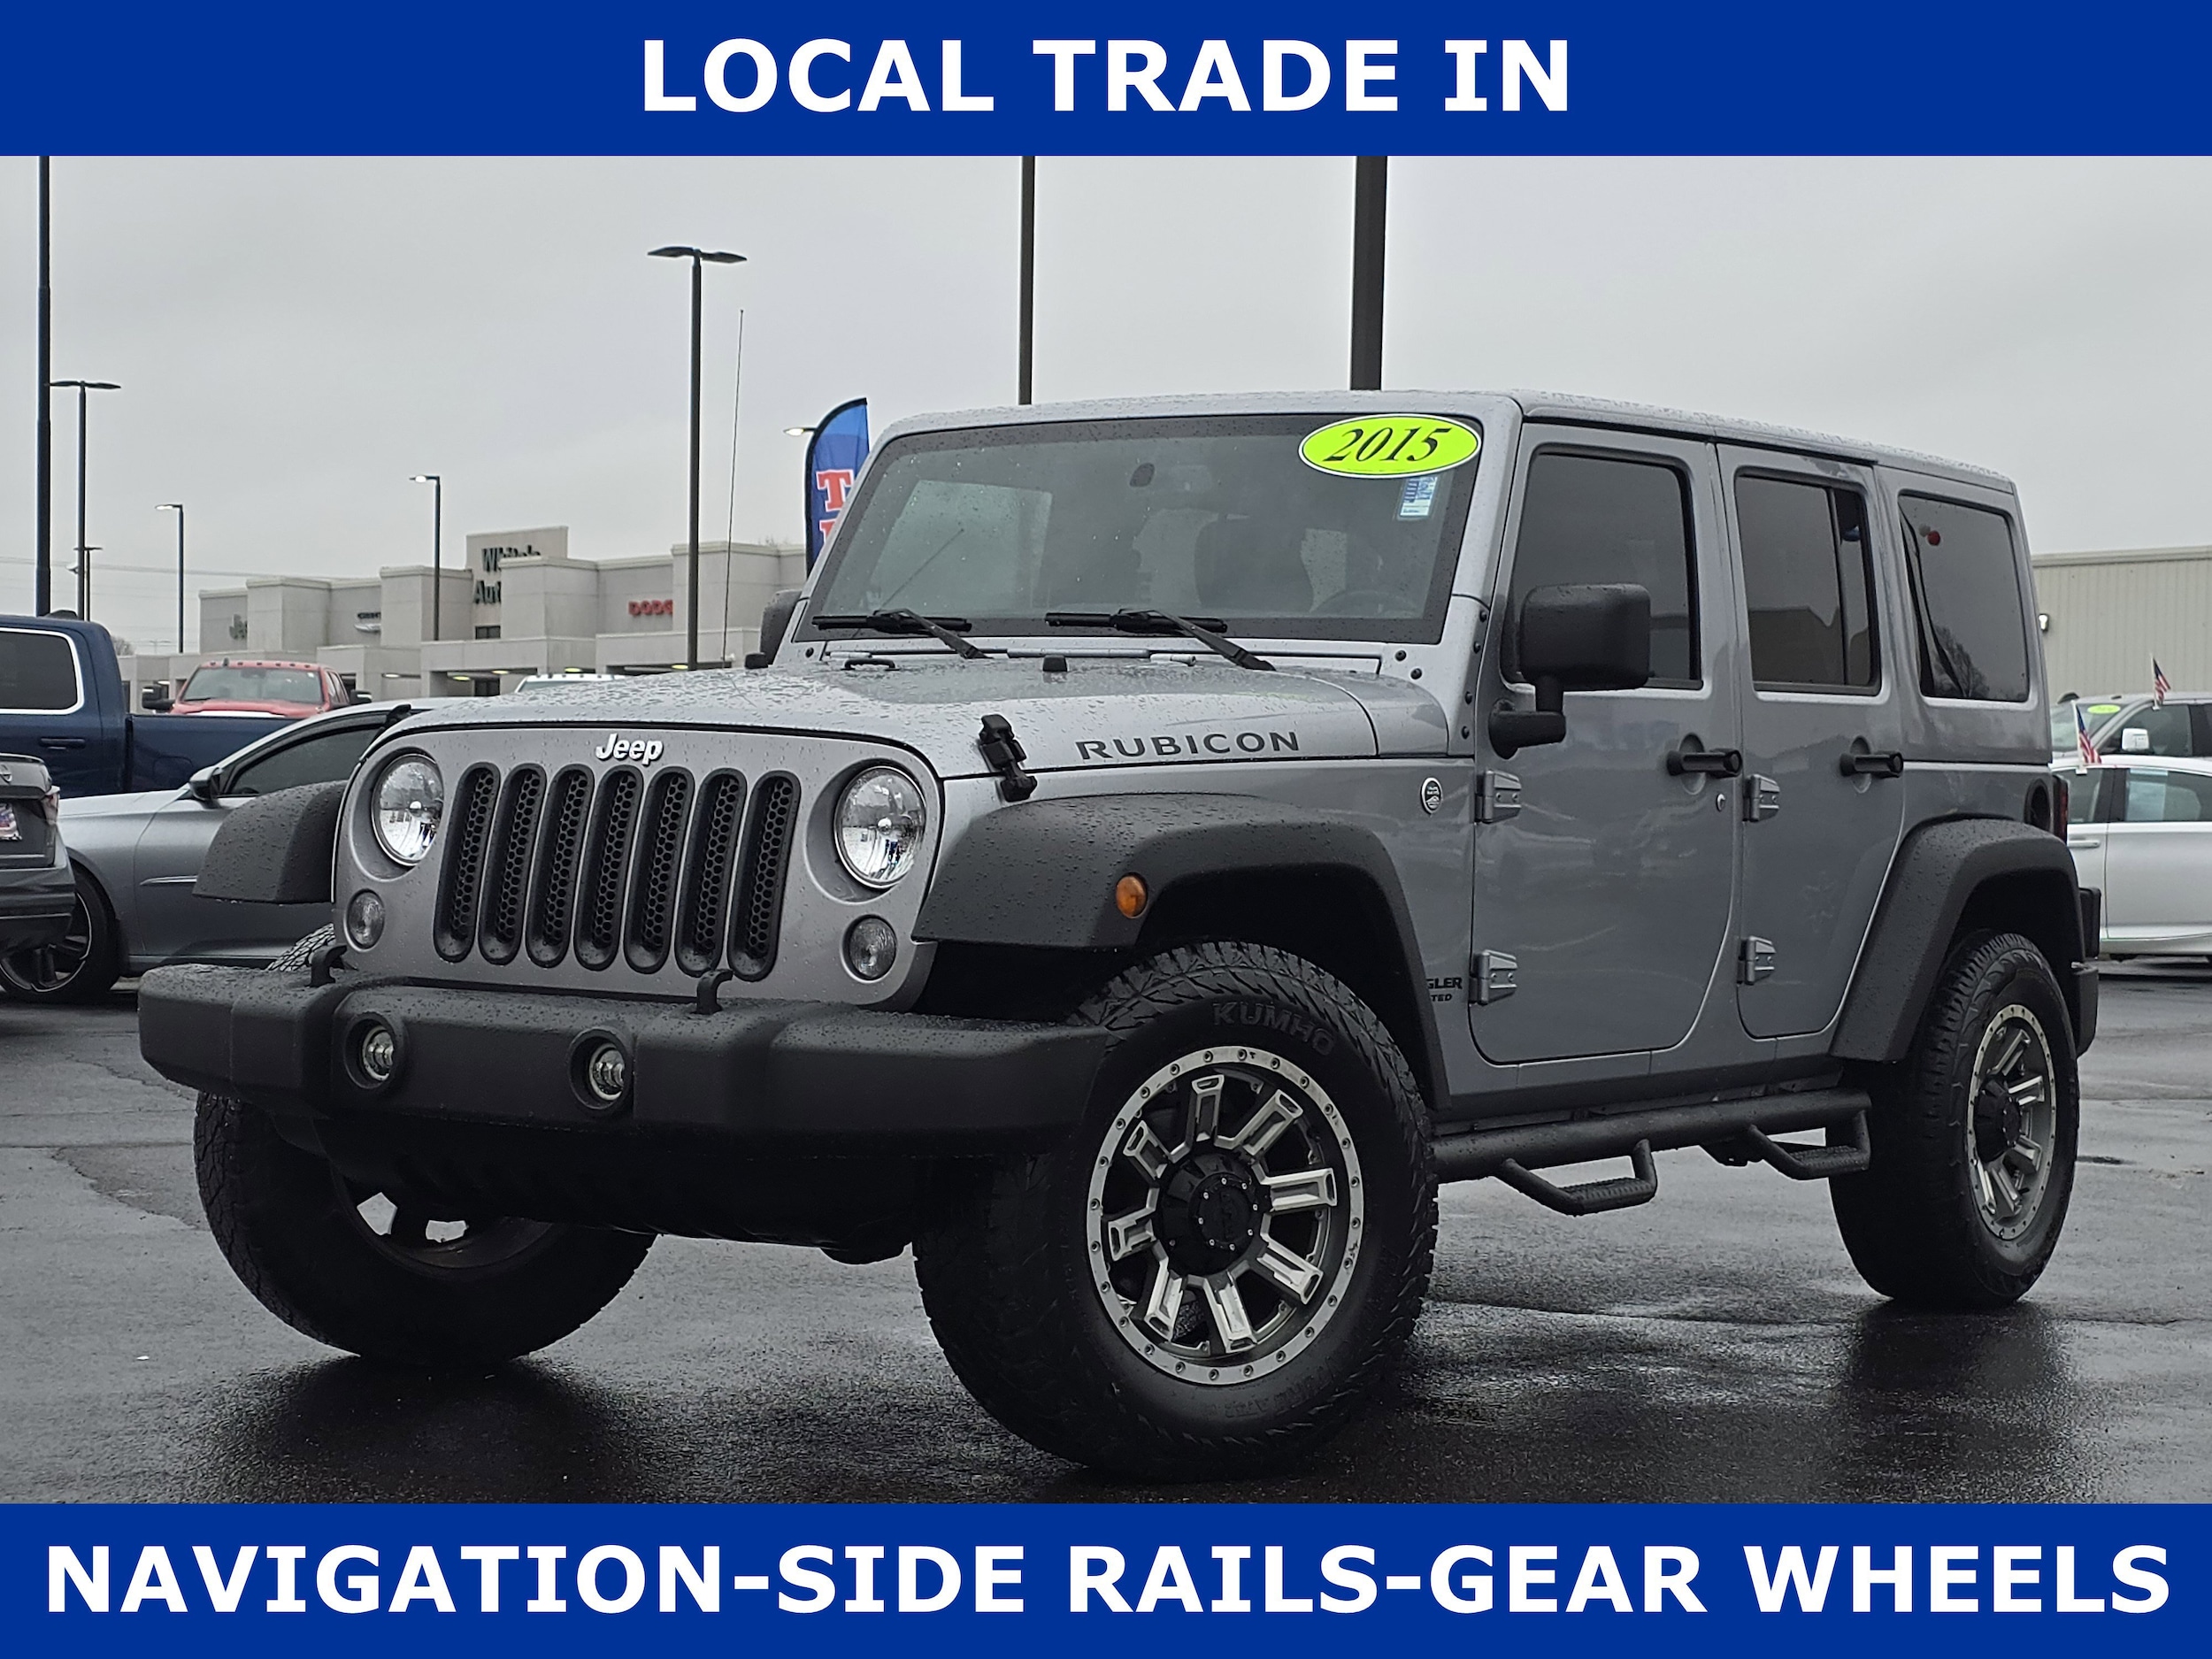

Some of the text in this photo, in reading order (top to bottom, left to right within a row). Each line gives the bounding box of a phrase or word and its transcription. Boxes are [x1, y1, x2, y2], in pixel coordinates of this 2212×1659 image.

[1323, 426, 1453, 462] 2015
[595, 733, 664, 767] Jeep
[1075, 731, 1300, 760] RUBICON
[1211, 1001, 1335, 1056] KUMHO
